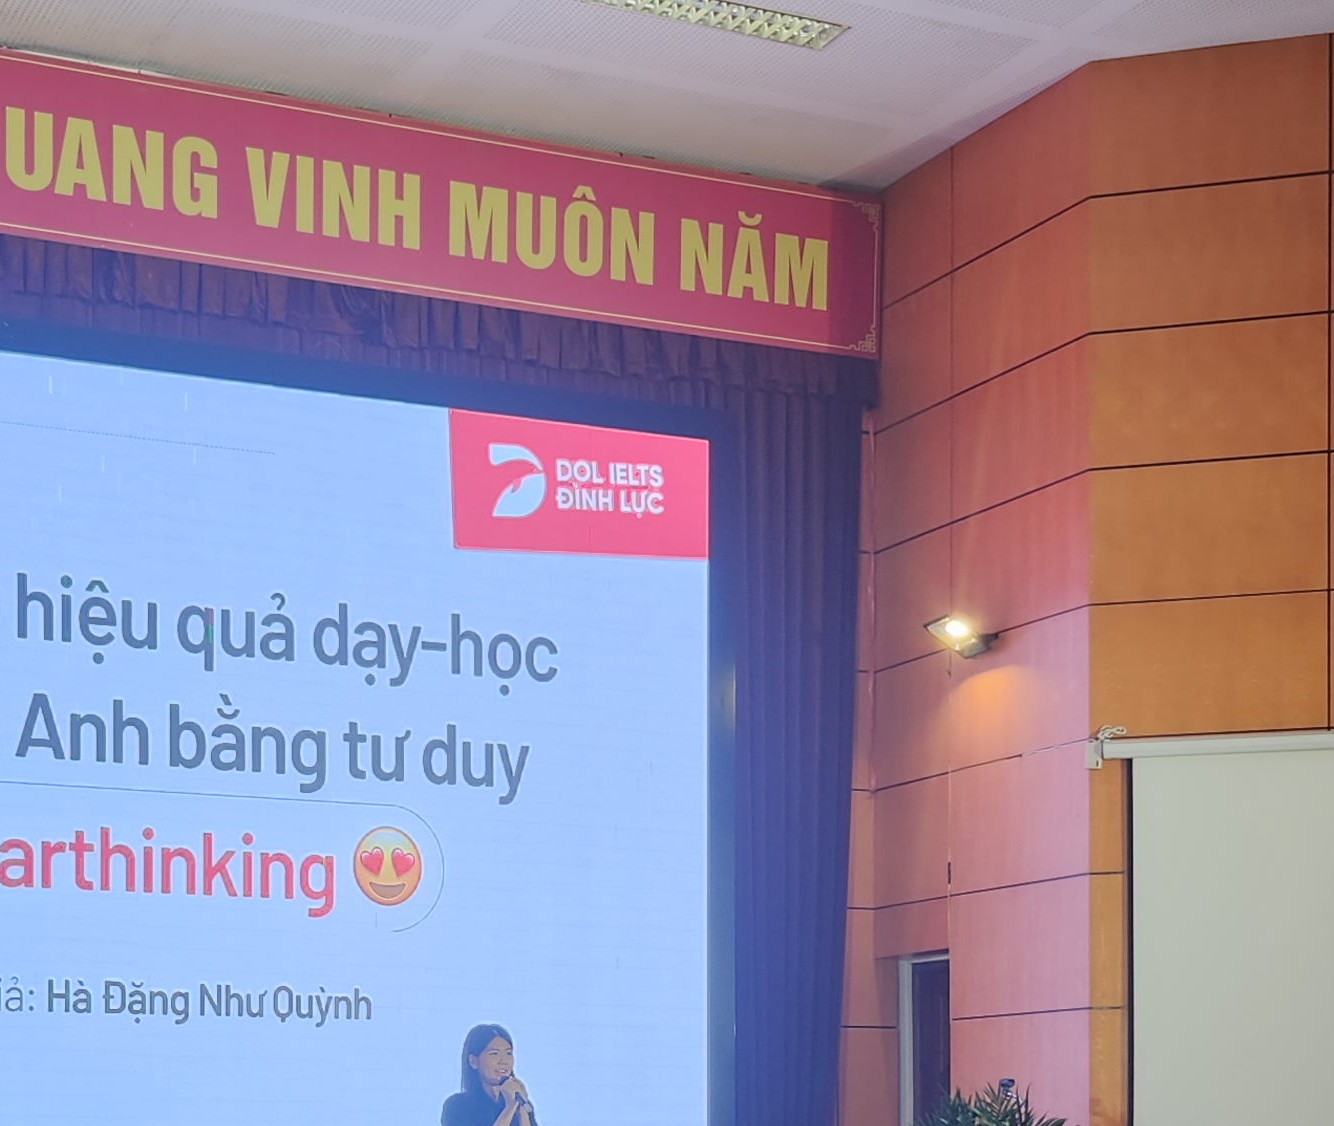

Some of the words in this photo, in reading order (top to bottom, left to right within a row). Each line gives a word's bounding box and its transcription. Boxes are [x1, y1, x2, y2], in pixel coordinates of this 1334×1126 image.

[247, 148, 420, 248] VINH
[450, 181, 654, 284] MUÔN
[681, 211, 828, 310] NĂM
[555, 458, 603, 484] DOL
[609, 462, 665, 487] IELTS
[555, 484, 614, 512] ĐÌNH
[619, 489, 665, 518] LỰC
[16, 572, 158, 665] hiệu
[177, 592, 296, 673] quả
[313, 602, 558, 696] dạy-học
[15, 693, 149, 767] Anh
[169, 693, 327, 794] bằng
[343, 721, 412, 783] tư
[422, 724, 531, 806] duy
[47, 979, 93, 1014] Hà
[101, 980, 191, 1026] Đặng
[199, 983, 269, 1018] Như
[273, 985, 373, 1029] Quỳnh
